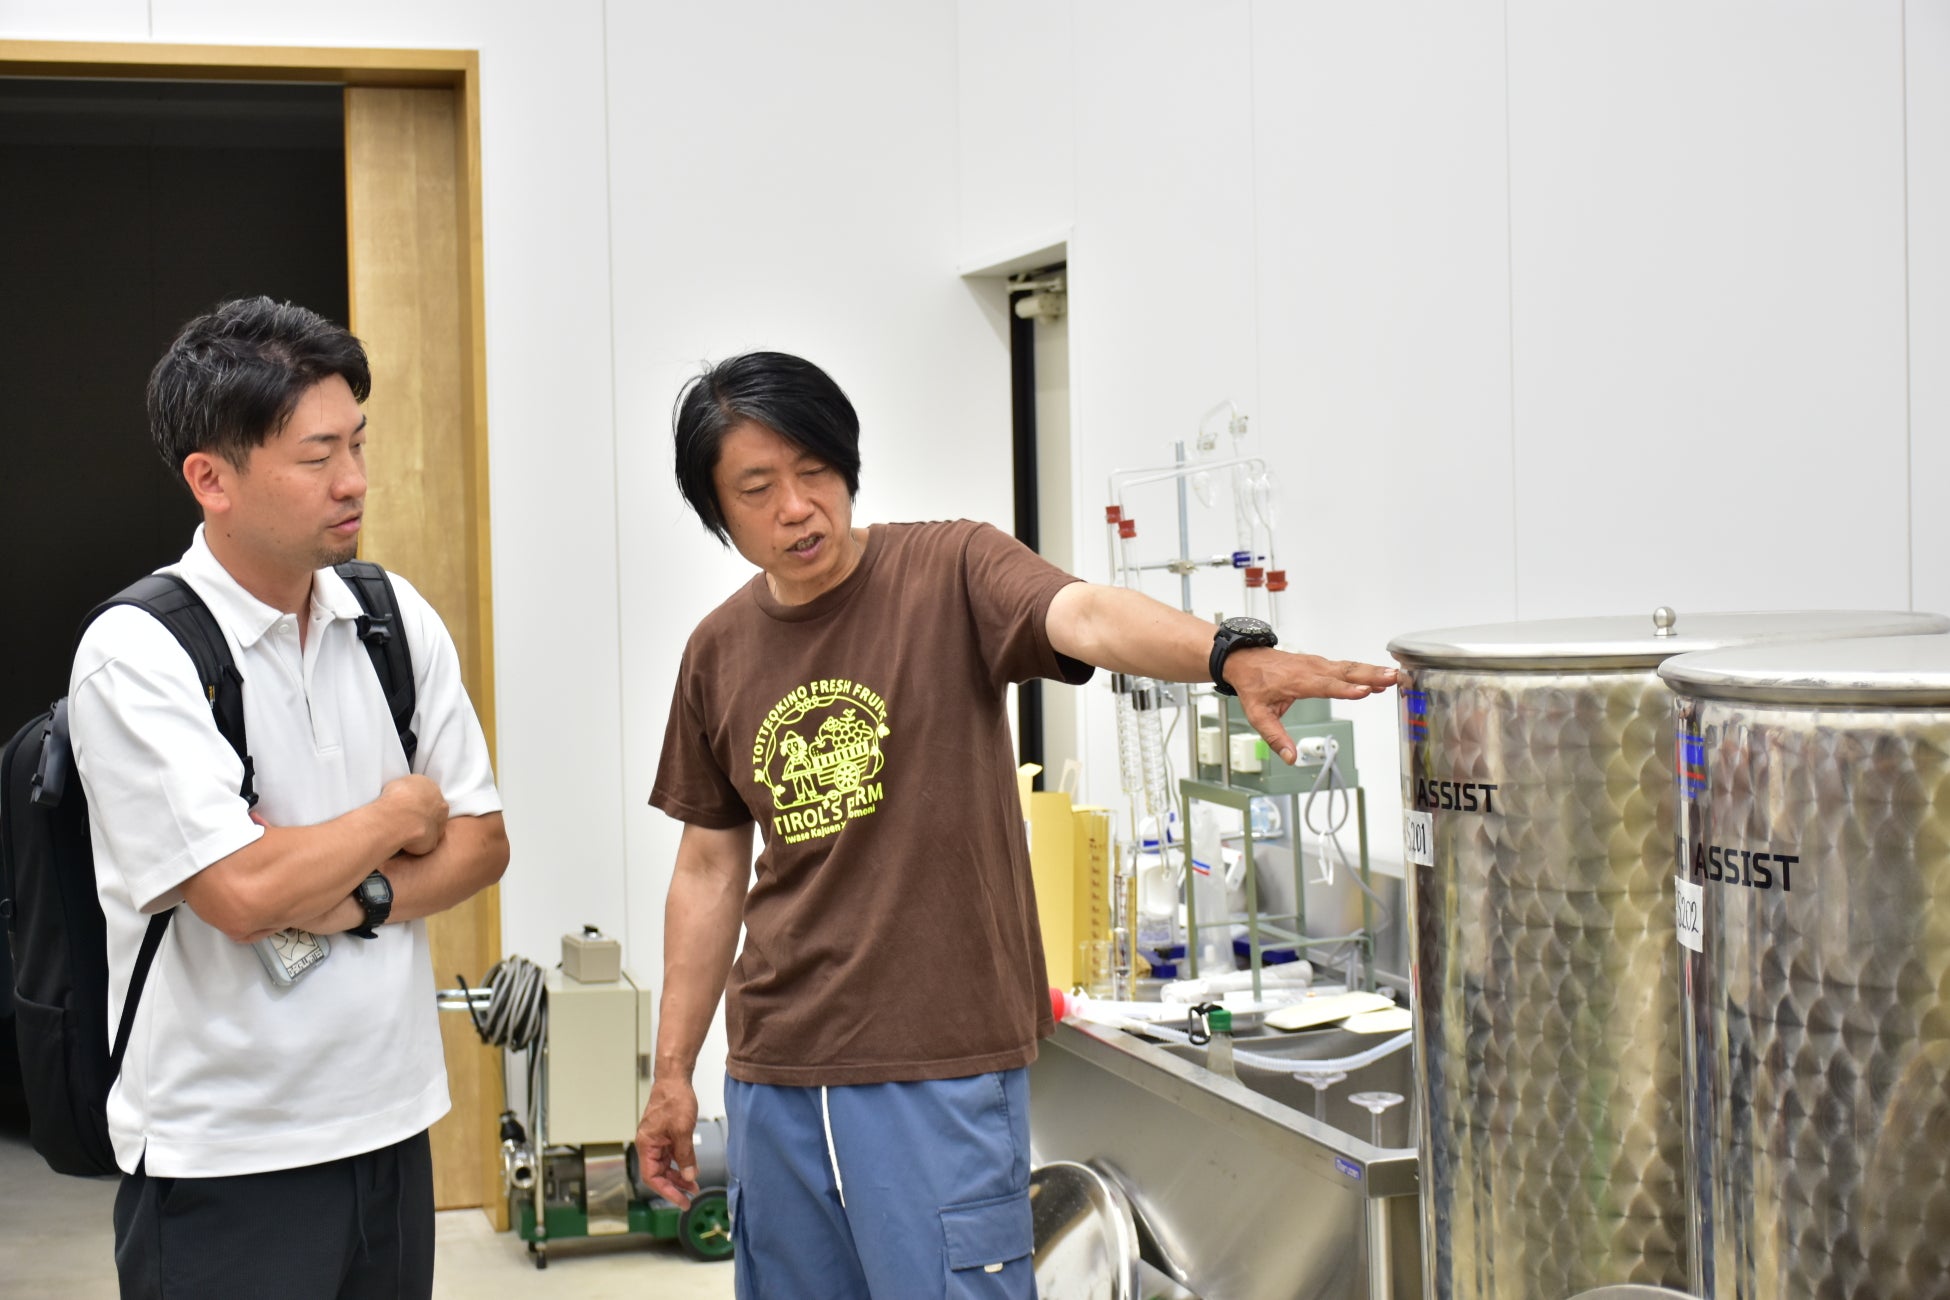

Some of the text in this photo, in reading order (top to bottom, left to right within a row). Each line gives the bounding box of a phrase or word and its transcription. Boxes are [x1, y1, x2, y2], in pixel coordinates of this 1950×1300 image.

[753, 685, 808, 764] TOTTEOKINO
[810, 679, 852, 695] FRESH
[846, 782, 883, 809] FRM
[1417, 778, 1498, 813] ASSIST
[785, 831, 810, 845] Iwase
[811, 824, 842, 838] Kajuen
[1694, 842, 1800, 892] ASSIST
[1677, 890, 1699, 933] S202
